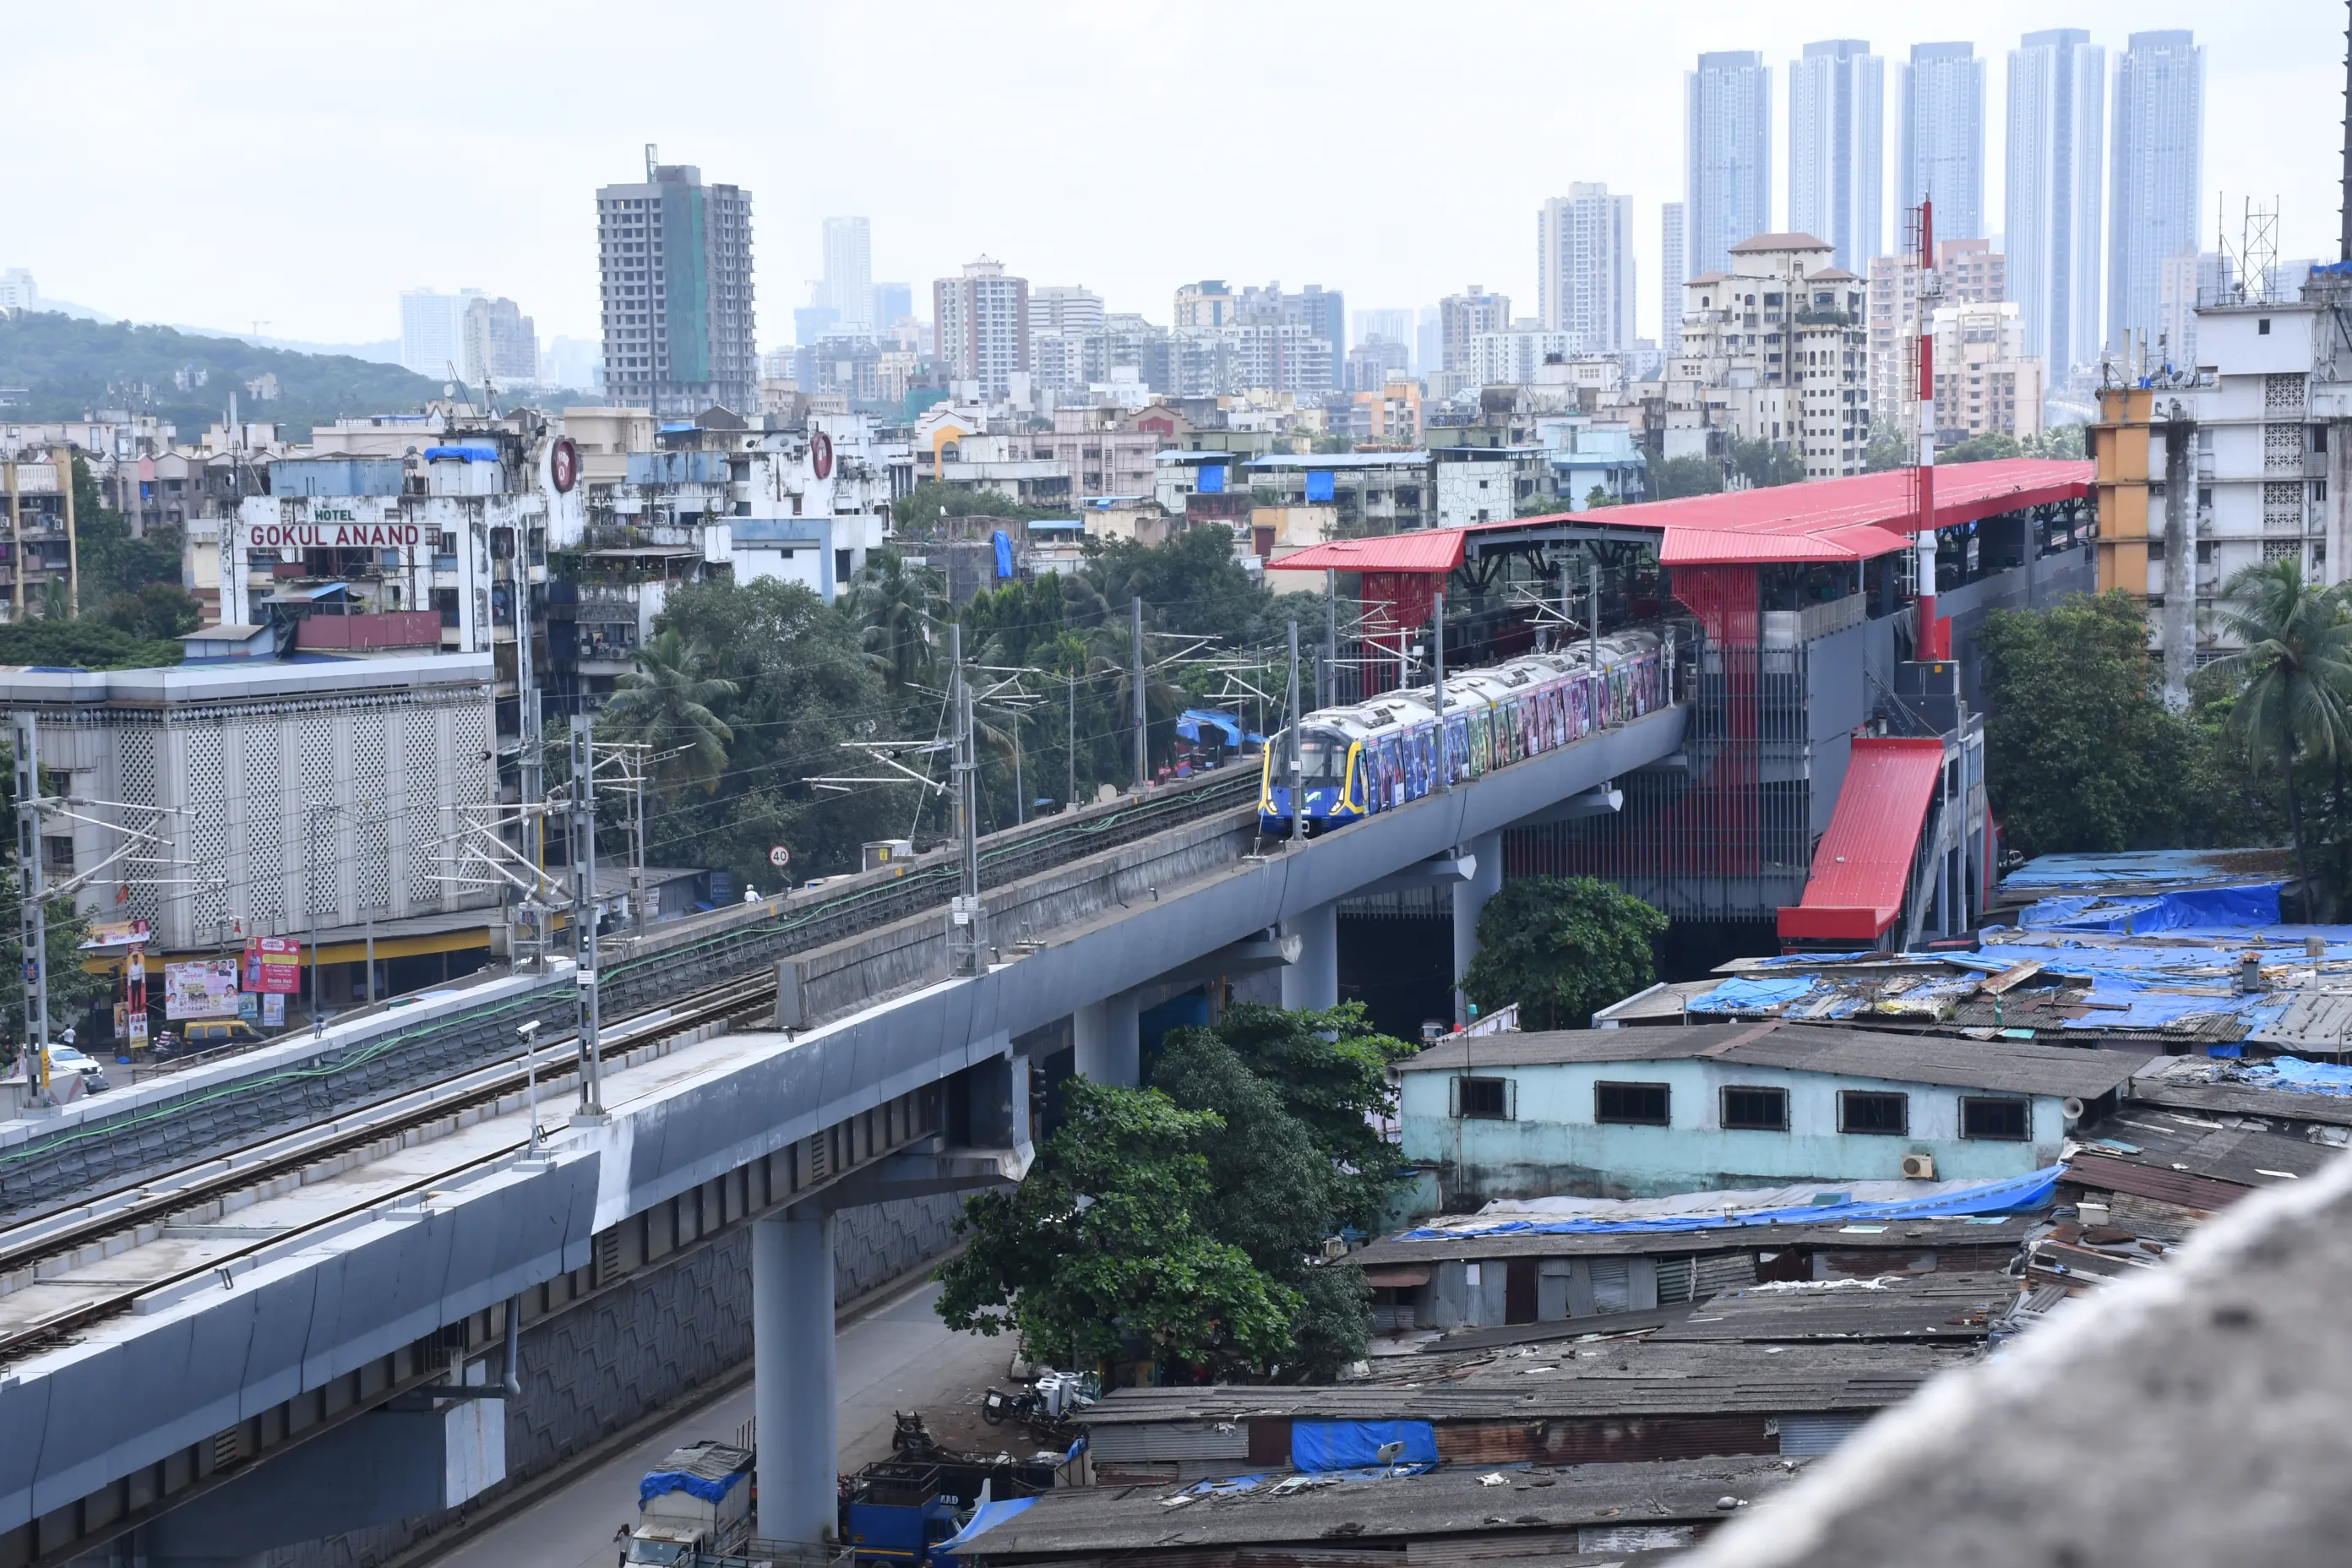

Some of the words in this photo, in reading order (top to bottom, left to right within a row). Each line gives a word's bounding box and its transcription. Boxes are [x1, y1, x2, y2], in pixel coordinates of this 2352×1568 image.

[314, 509, 356, 521] HOTEL
[250, 525, 328, 546] GOKUL
[335, 525, 419, 546] ANAND
[773, 851, 787, 861] 40
